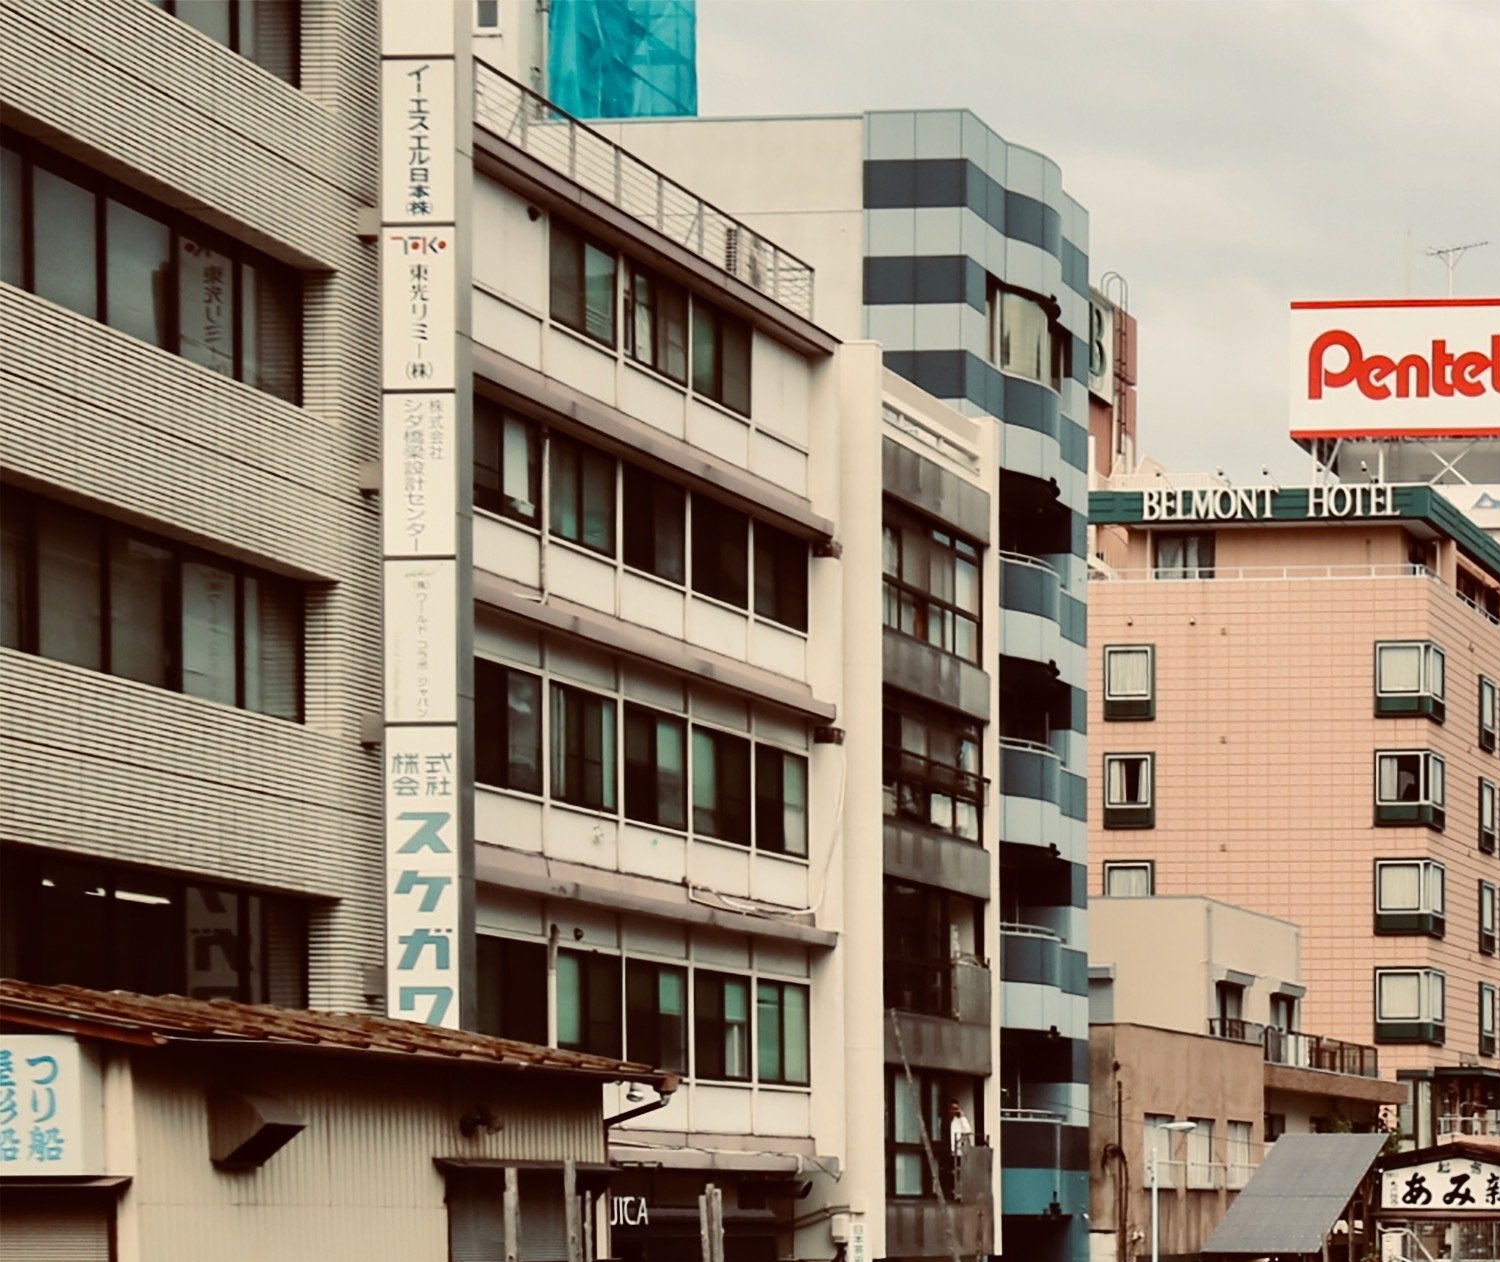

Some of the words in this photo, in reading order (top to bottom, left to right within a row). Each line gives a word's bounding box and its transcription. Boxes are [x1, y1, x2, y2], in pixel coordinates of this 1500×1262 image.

[429, 399, 444, 460] 株式会社
[1142, 487, 1279, 521] BELMONT
[1307, 483, 1401, 518] HOTEL
[393, 811, 455, 1031] スケガワ
[25, 1055, 65, 1163] つり船
